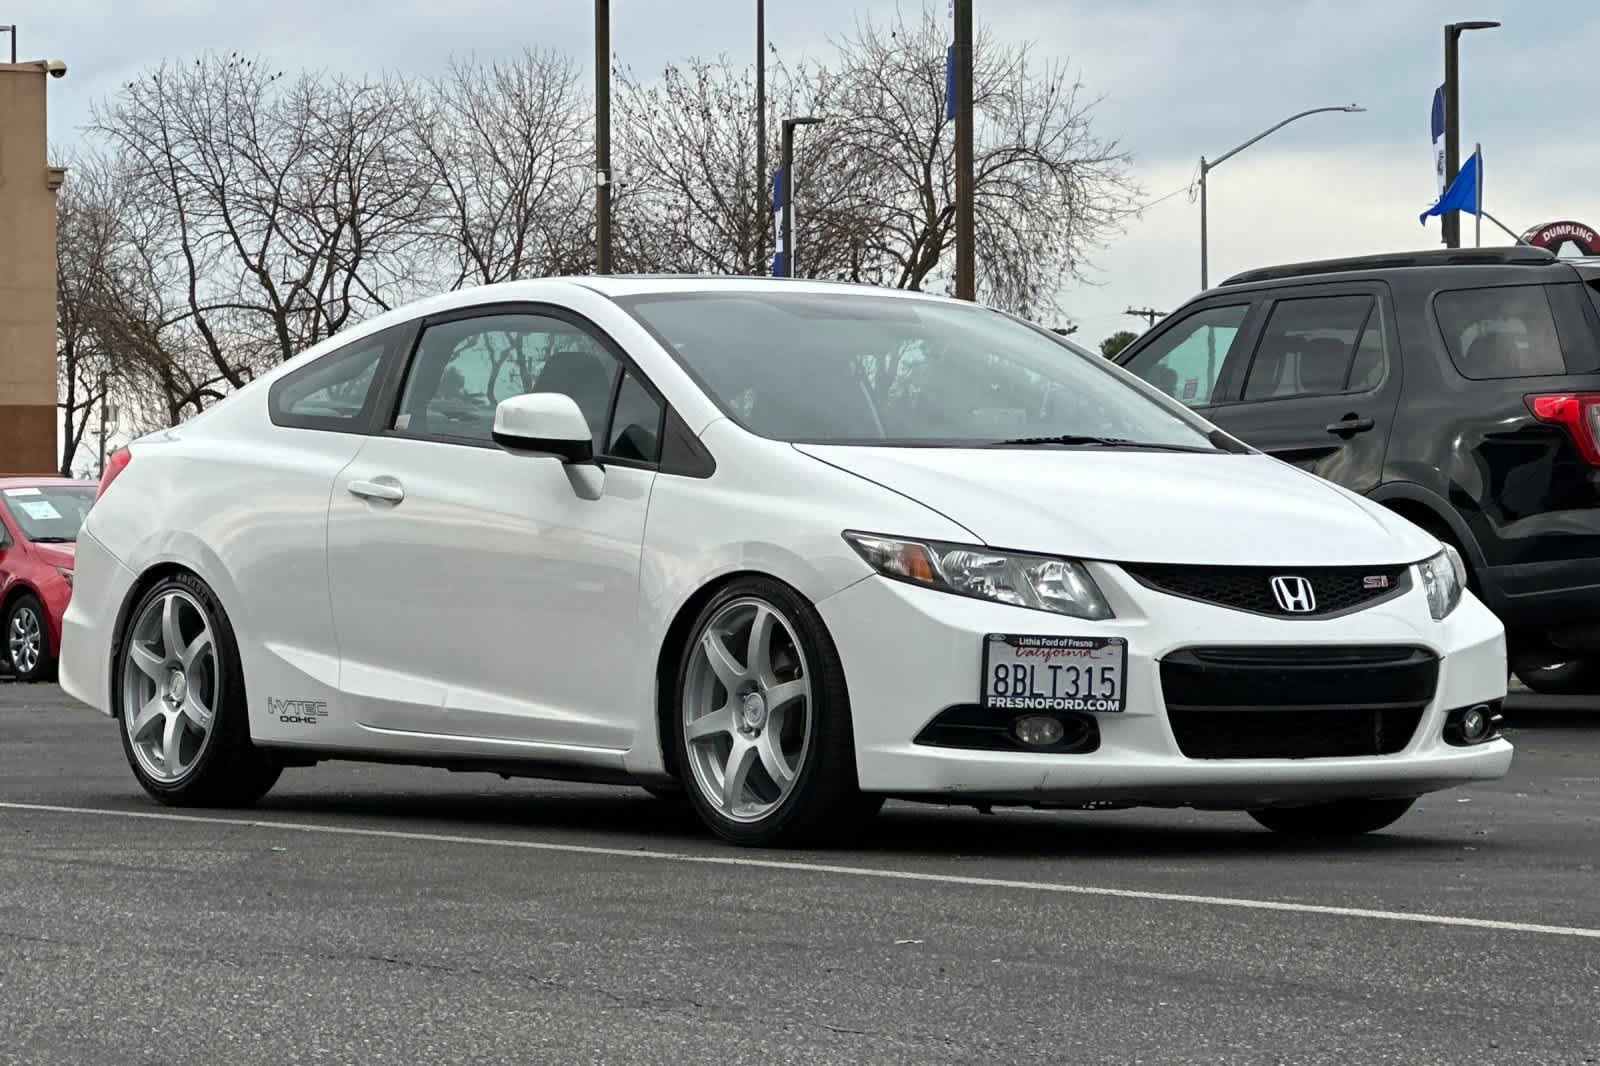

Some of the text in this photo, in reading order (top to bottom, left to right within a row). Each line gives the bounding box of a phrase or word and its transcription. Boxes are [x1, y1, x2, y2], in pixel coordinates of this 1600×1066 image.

[1542, 224, 1594, 242] DUMPLING
[1019, 637, 1094, 648] Lithia Ford of Fresno
[993, 663, 1116, 699] 8BLT315
[987, 697, 1120, 712] FRESNOFORD.COM
